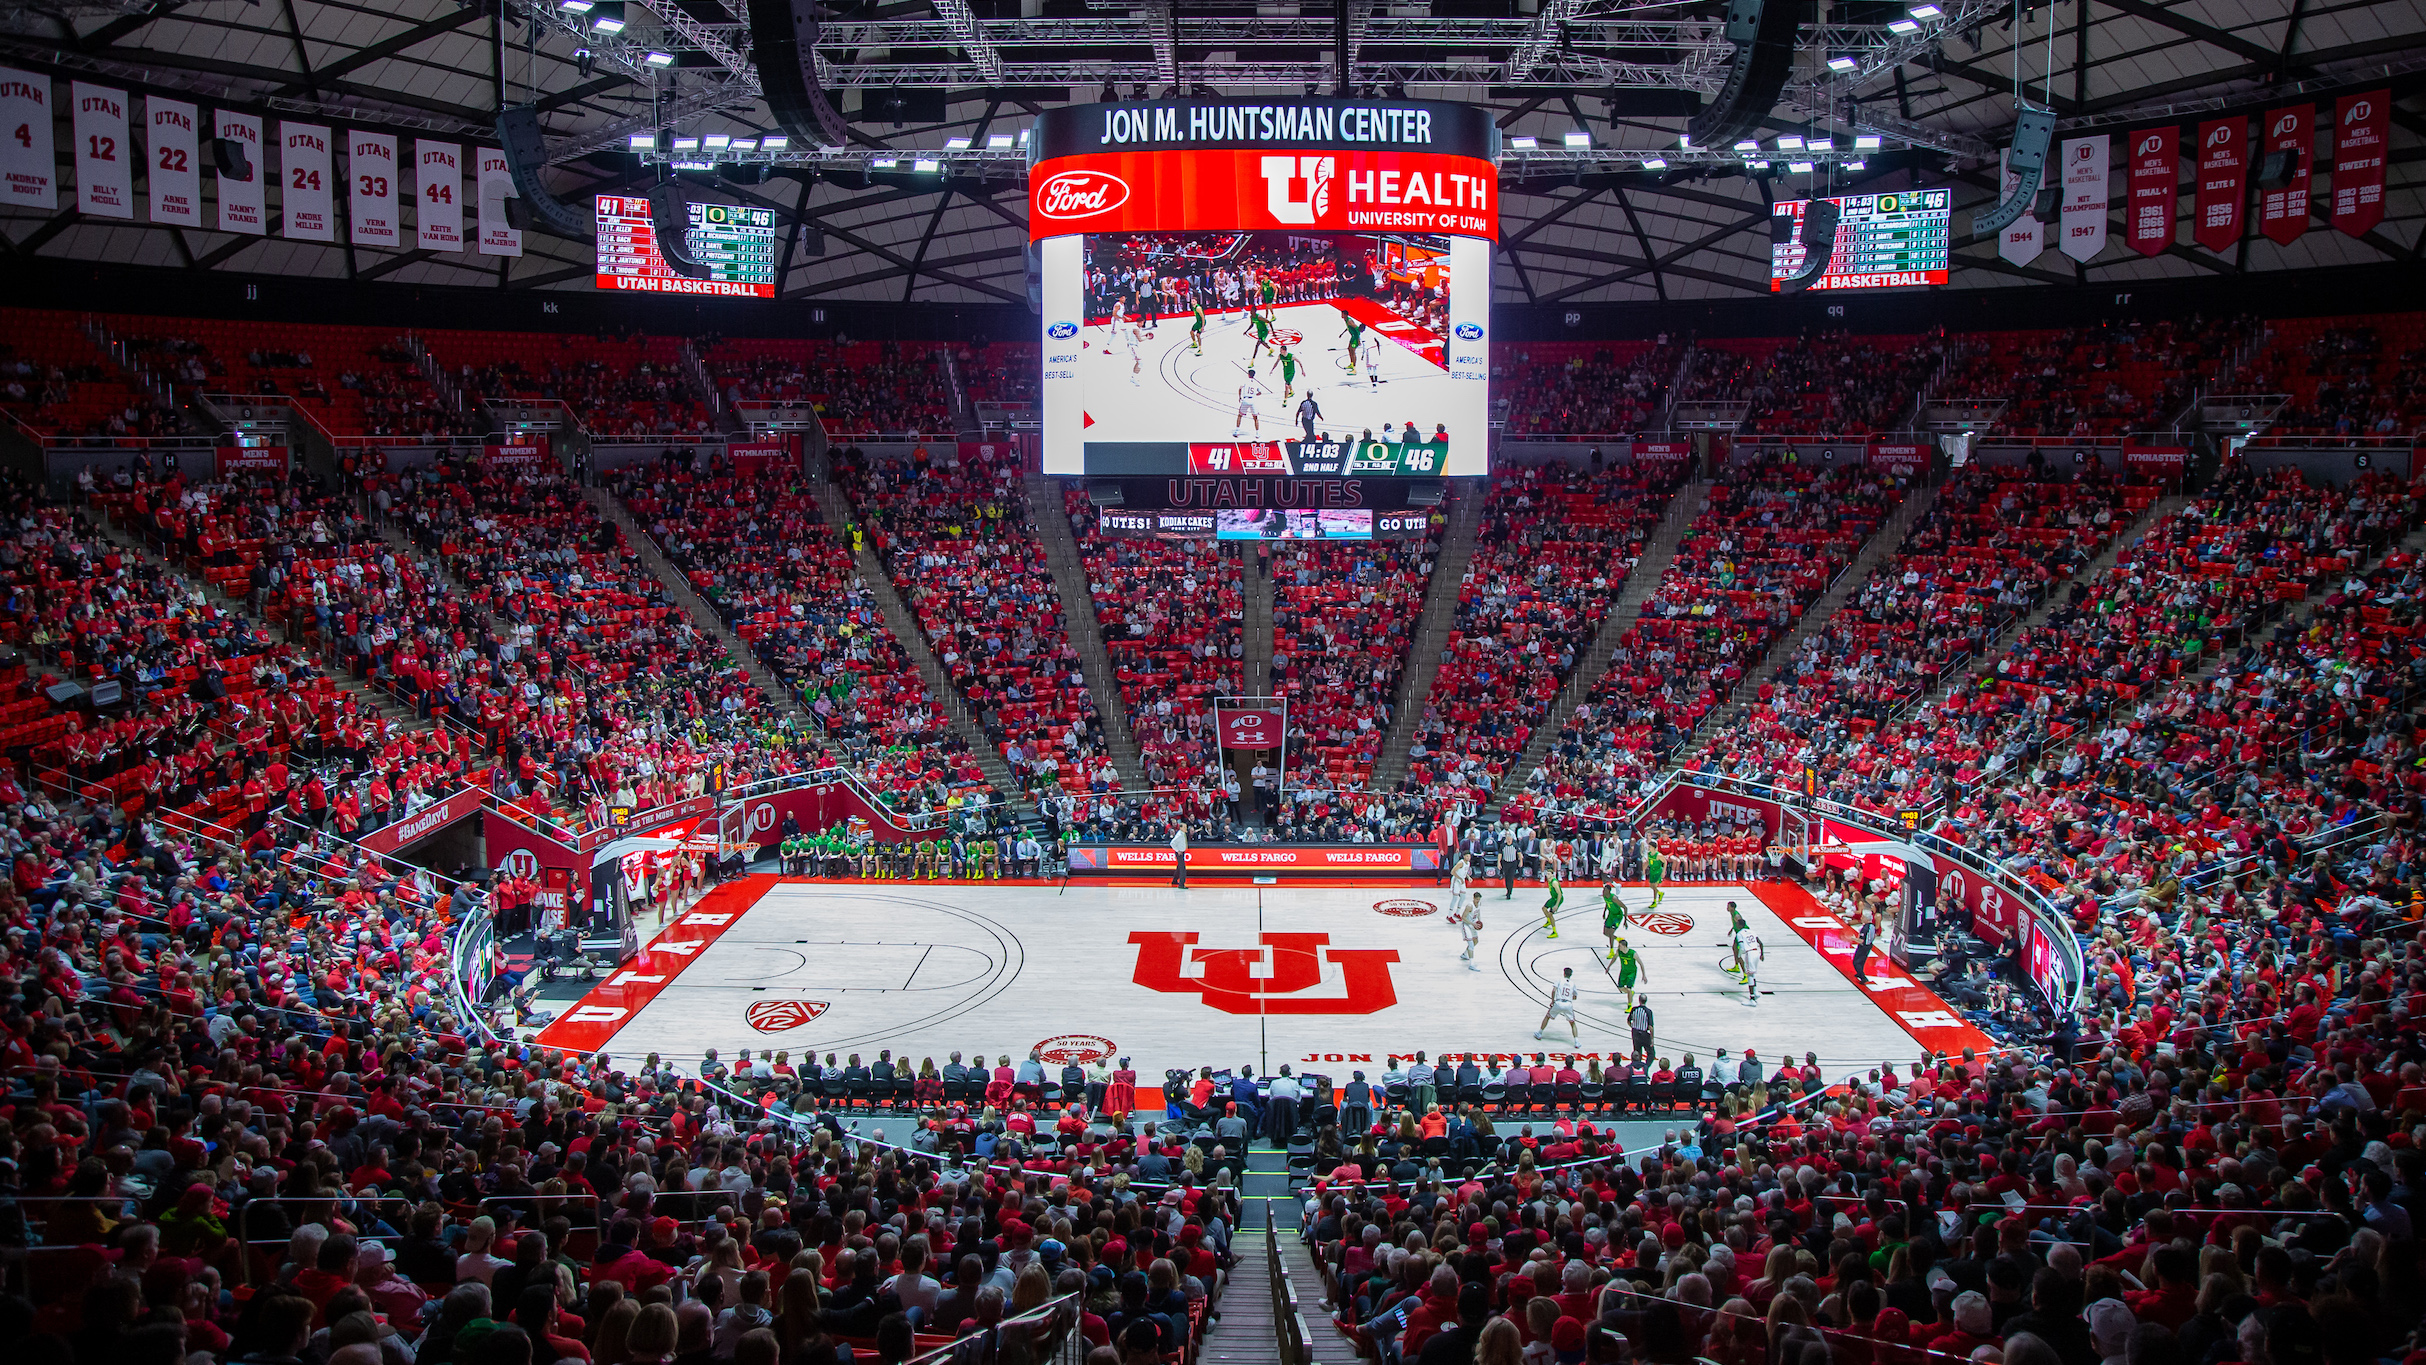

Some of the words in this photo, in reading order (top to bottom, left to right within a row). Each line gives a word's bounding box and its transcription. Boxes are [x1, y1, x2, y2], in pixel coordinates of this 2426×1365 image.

[1, 82, 43, 106] UTAH
[82, 97, 121, 119] UTAH
[155, 111, 191, 132] UTAH
[1101, 108, 1148, 144] JON
[1154, 107, 1184, 142] M.
[1189, 106, 1333, 141] HUNTSMAN
[1339, 107, 1432, 144] CENTER
[15, 123, 31, 148] 4
[223, 124, 256, 144] UTAH
[2351, 127, 2371, 138] MEN'S
[289, 134, 324, 153] UTAH
[2279, 139, 2297, 149] MEN'S
[2340, 135, 2380, 149] BASKETBALL
[89, 135, 116, 162] 12
[357, 143, 391, 161] UTAH
[159, 146, 188, 173] 22
[423, 151, 455, 169] UTAH
[2213, 150, 2231, 160] MEN'S
[484, 159, 511, 173] UTA
[2144, 159, 2162, 168] MEN'S
[2203, 158, 2239, 170] BASKETBALL
[2338, 159, 2370, 172] SWEET
[2370, 157, 2381, 167] 16
[2076, 166, 2093, 175] MEN'S
[2135, 166, 2171, 177] BASKETBALL
[2297, 169, 2307, 177] 16
[5, 173, 48, 186] ANDREW
[293, 168, 321, 191] 24
[2067, 174, 2102, 184] BASKETBALL
[2205, 180, 2228, 190] ELITE
[2229, 179, 2236, 187] 8
[12, 184, 43, 196] BOGUT
[93, 185, 118, 195] BILLY
[359, 175, 388, 198] 33
[1349, 169, 1487, 211] HEALTH
[2136, 187, 2161, 198] FINAL
[2162, 186, 2168, 195] 4
[2337, 187, 2357, 198] 1983
[426, 183, 452, 204] 44
[1045, 177, 1109, 213] Ford
[2077, 195, 2091, 203] NIT
[2266, 192, 2285, 203] 1955
[2287, 190, 2307, 200] 1977
[90, 194, 121, 206] MCGILL
[163, 195, 188, 205] ARNIE
[1846, 197, 1873, 207] 14:03
[1879, 196, 1897, 212] O
[1924, 192, 1945, 209] 46
[2265, 201, 2285, 212] 1959
[2287, 198, 2307, 208] 1978
[2337, 196, 2356, 207] 1991
[2359, 193, 2380, 204] 2015
[162, 204, 190, 215] FERRIN
[229, 204, 256, 214] DANNY
[600, 198, 619, 215] 41
[2062, 202, 2106, 213] CHAMPIONS
[2139, 205, 2164, 218] 1961
[2206, 203, 2233, 217] 1956
[2336, 205, 2356, 216] 1996
[227, 213, 258, 224] VRANES
[296, 212, 323, 222] ANDRE
[708, 207, 726, 222] O
[751, 211, 770, 226] 46
[2265, 210, 2284, 220] 1960
[2287, 207, 2306, 218] 1981
[295, 221, 323, 230] MILLER
[365, 218, 386, 227] VERN
[1348, 211, 1436, 227] UNIVERSITY
[1439, 213, 1457, 228] OF
[1459, 215, 1487, 231] UTAH
[2138, 216, 2165, 229] 1966
[2205, 215, 2233, 228] 1997
[358, 226, 393, 236] GARDNER
[430, 225, 452, 233] KEITH
[492, 230, 509, 238] RICK
[615, 225, 633, 233] ALLEN
[2071, 226, 2096, 238] 1947
[2138, 227, 2165, 240] 1998
[422, 232, 439, 241] VAN
[440, 234, 460, 242] HORN
[484, 238, 517, 247] MAJERUS
[2009, 231, 2033, 243] 1944
[616, 277, 658, 290] UTAH
[661, 279, 759, 296] BASKETBALL
[1831, 272, 1930, 289] BASKETBALL
[2115, 292, 2132, 305] rr
[543, 301, 559, 314] kk
[1827, 305, 1845, 317] qq
[1565, 312, 1581, 324] pp
[1052, 323, 1073, 337] Ford
[1459, 324, 1480, 339] Ford
[1048, 354, 1078, 364] AMERICA'S
[1455, 355, 1483, 365] AMERICA'S
[1451, 371, 1487, 381] BEST-SELLING
[242, 449, 269, 459] MEN'S
[499, 447, 537, 456] WOMEN'S
[1299, 443, 1340, 459] 14:03
[1366, 443, 1389, 461] O
[1647, 445, 1671, 453] MEN'S
[1824, 450, 1833, 460] Q
[1878, 446, 1916, 455] WOMEN'S
[165, 456, 174, 466] H
[491, 455, 543, 464] BASKETBALL
[1207, 448, 1232, 471] 41
[1404, 448, 1435, 471] 46
[1636, 452, 1684, 460] BASKETBALL
[1871, 454, 1924, 463] BASKETBALL
[2076, 452, 2083, 462] R
[2127, 453, 2185, 462] GYMNASTICS
[2358, 456, 2367, 467] S
[1302, 462, 1320, 472] 2ND
[1320, 462, 1339, 472] HALF
[1168, 478, 1262, 507] UTAH
[1274, 478, 1363, 507] UTES
[1111, 516, 1151, 529] UTES!
[1159, 516, 1188, 528] KODIAK
[1188, 516, 1213, 528] CAKES
[1379, 518, 1401, 531] GO
[641, 813, 655, 827] THE
[655, 809, 674, 821] MUSS
[756, 808, 772, 828] U
[1709, 800, 1757, 825] UTES
[1901, 811, 1918, 820] 14:03
[1116, 852, 1154, 862] WELLS
[1155, 852, 1192, 863] FARO
[1221, 852, 1258, 862] WELLS
[1260, 852, 1297, 863] FARGO
[1326, 852, 1363, 862] WELLS
[1364, 852, 1401, 863] FARGO
[543, 893, 565, 908] AKE
[1655, 923, 1685, 934] 12
[1746, 934, 1755, 943] 32
[566, 912, 734, 1022] UTAH
[1561, 987, 1570, 997] 15
[748, 1000, 828, 1020] PAC
[757, 1017, 796, 1028] 12
[1301, 1053, 1372, 1062] JON
[1681, 1070, 1700, 1079] UTES
